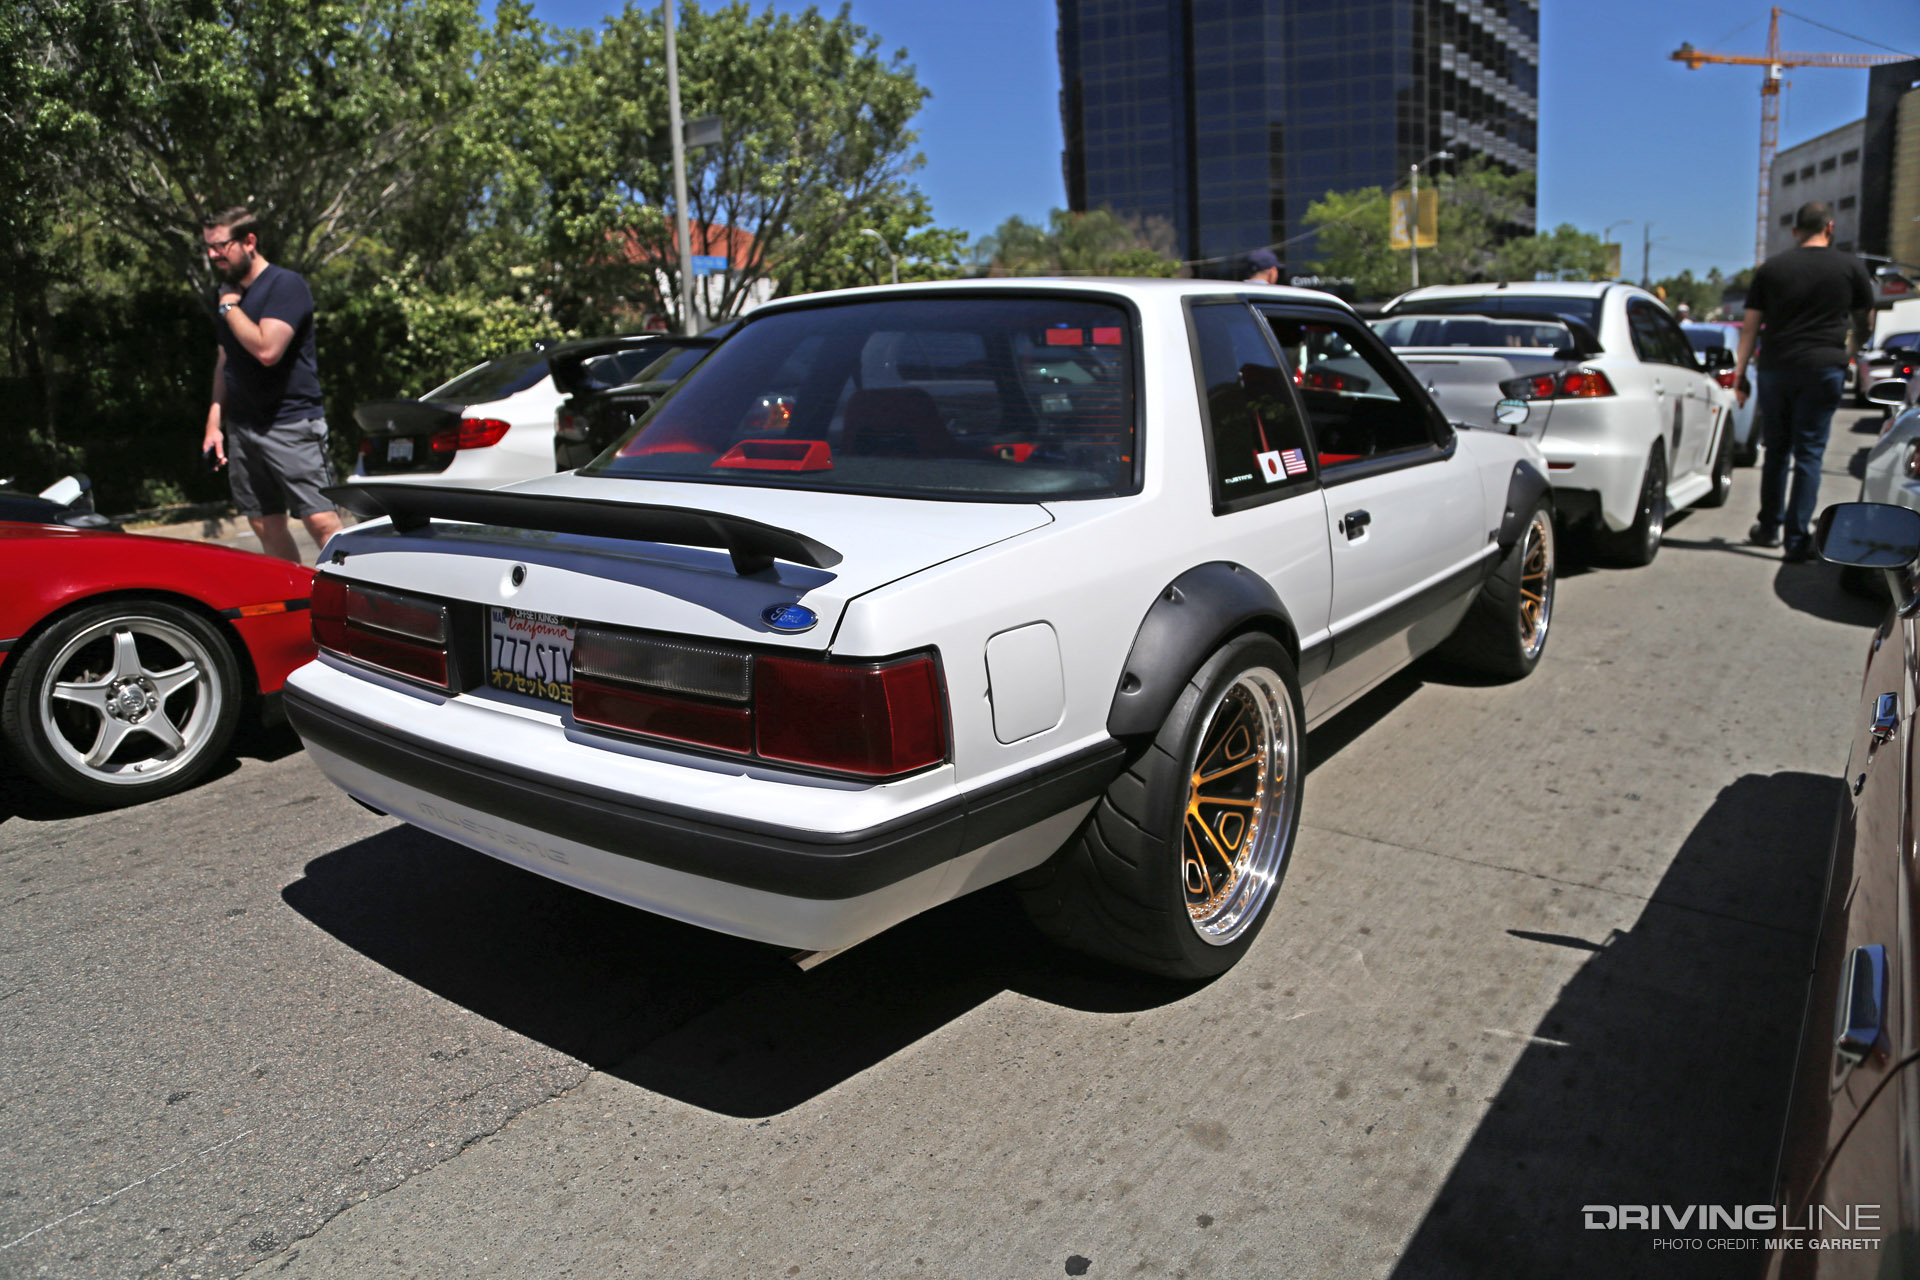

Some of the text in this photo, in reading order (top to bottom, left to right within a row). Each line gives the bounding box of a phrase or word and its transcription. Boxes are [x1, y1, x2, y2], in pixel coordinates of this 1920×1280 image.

[537, 612, 559, 625] KINGS
[770, 606, 805, 624] Ford
[508, 614, 574, 641] California
[492, 669, 573, 704] オフセットの王
